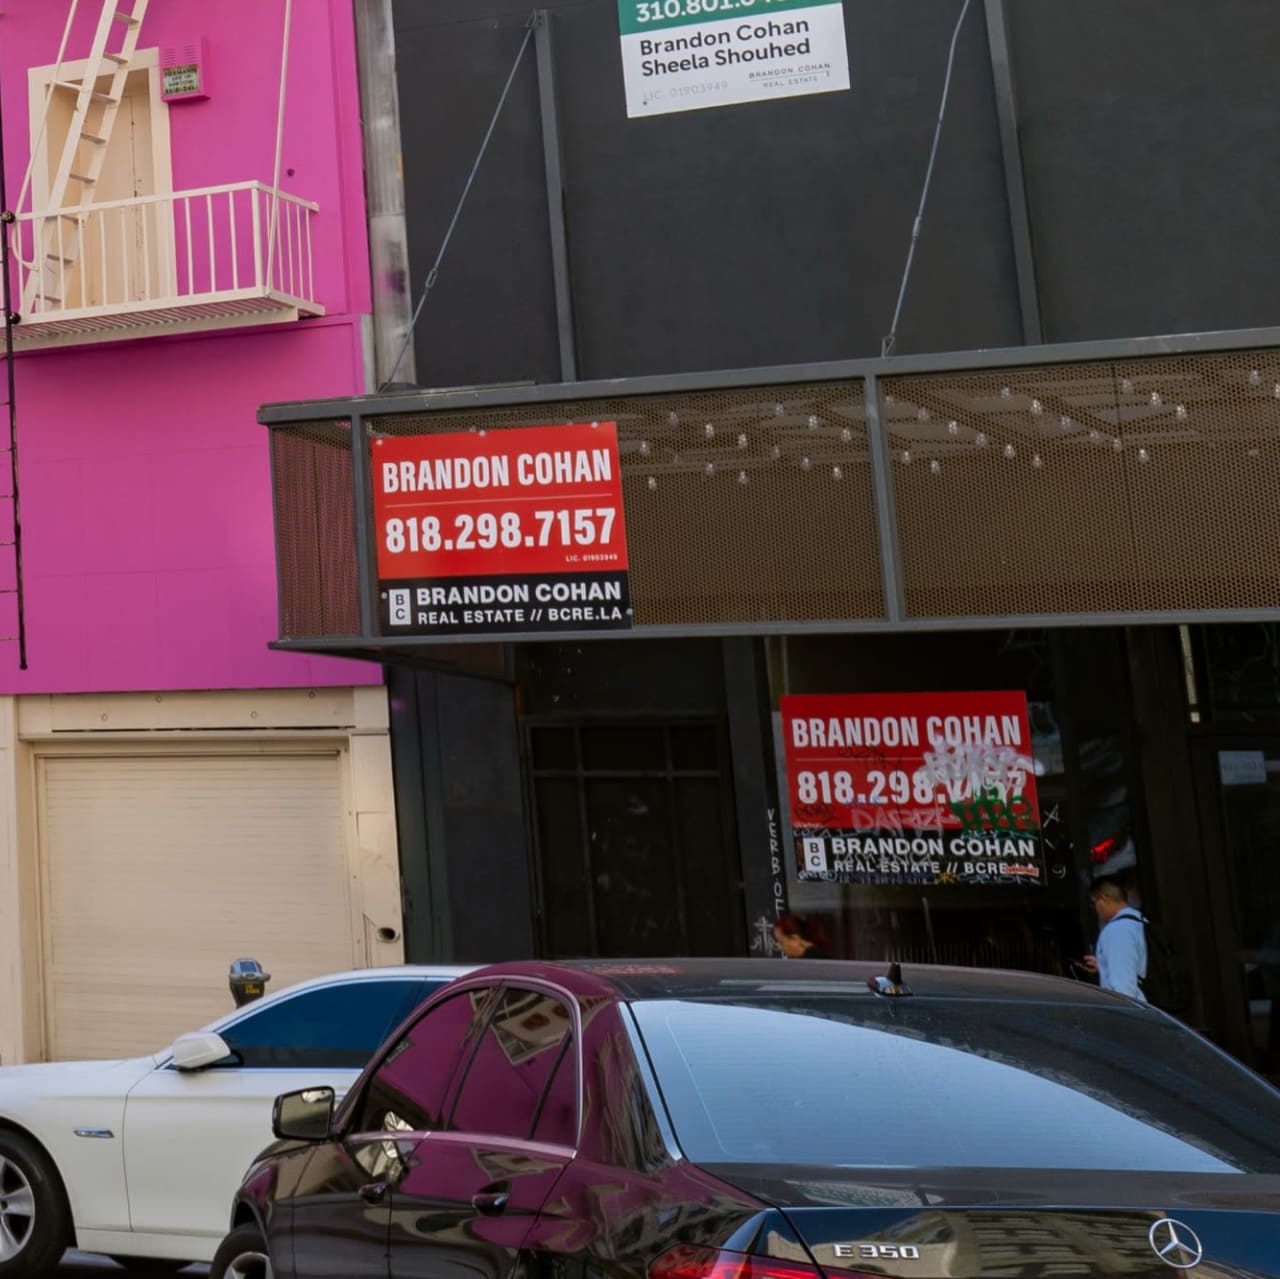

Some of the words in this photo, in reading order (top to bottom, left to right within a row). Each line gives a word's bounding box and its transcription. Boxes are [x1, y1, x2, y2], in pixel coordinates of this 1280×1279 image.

[640, 30, 731, 56] Brandon
[736, 19, 810, 42] Cohan
[641, 52, 710, 77] Sheela
[715, 37, 811, 66] Shouhed
[748, 66, 795, 79] BRANDON
[798, 62, 831, 73] COHAN
[382, 455, 509, 493] BRANDON
[517, 448, 612, 485] COHAN
[385, 507, 616, 553] 818.298.7157
[416, 584, 529, 606] BRANDON
[535, 581, 622, 602] COHAN
[418, 612, 458, 625] REAL
[463, 608, 525, 623] ESTATE
[548, 606, 622, 621] BCRE.LA
[792, 716, 920, 748] BRANDON
[926, 715, 1022, 746] COHAN
[831, 838, 944, 856] BRANDON
[950, 838, 1035, 857] COHAN
[834, 861, 875, 873] REAL
[880, 861, 941, 874] ESTATE
[833, 1243, 854, 1258] E
[858, 1243, 920, 1259] 350
